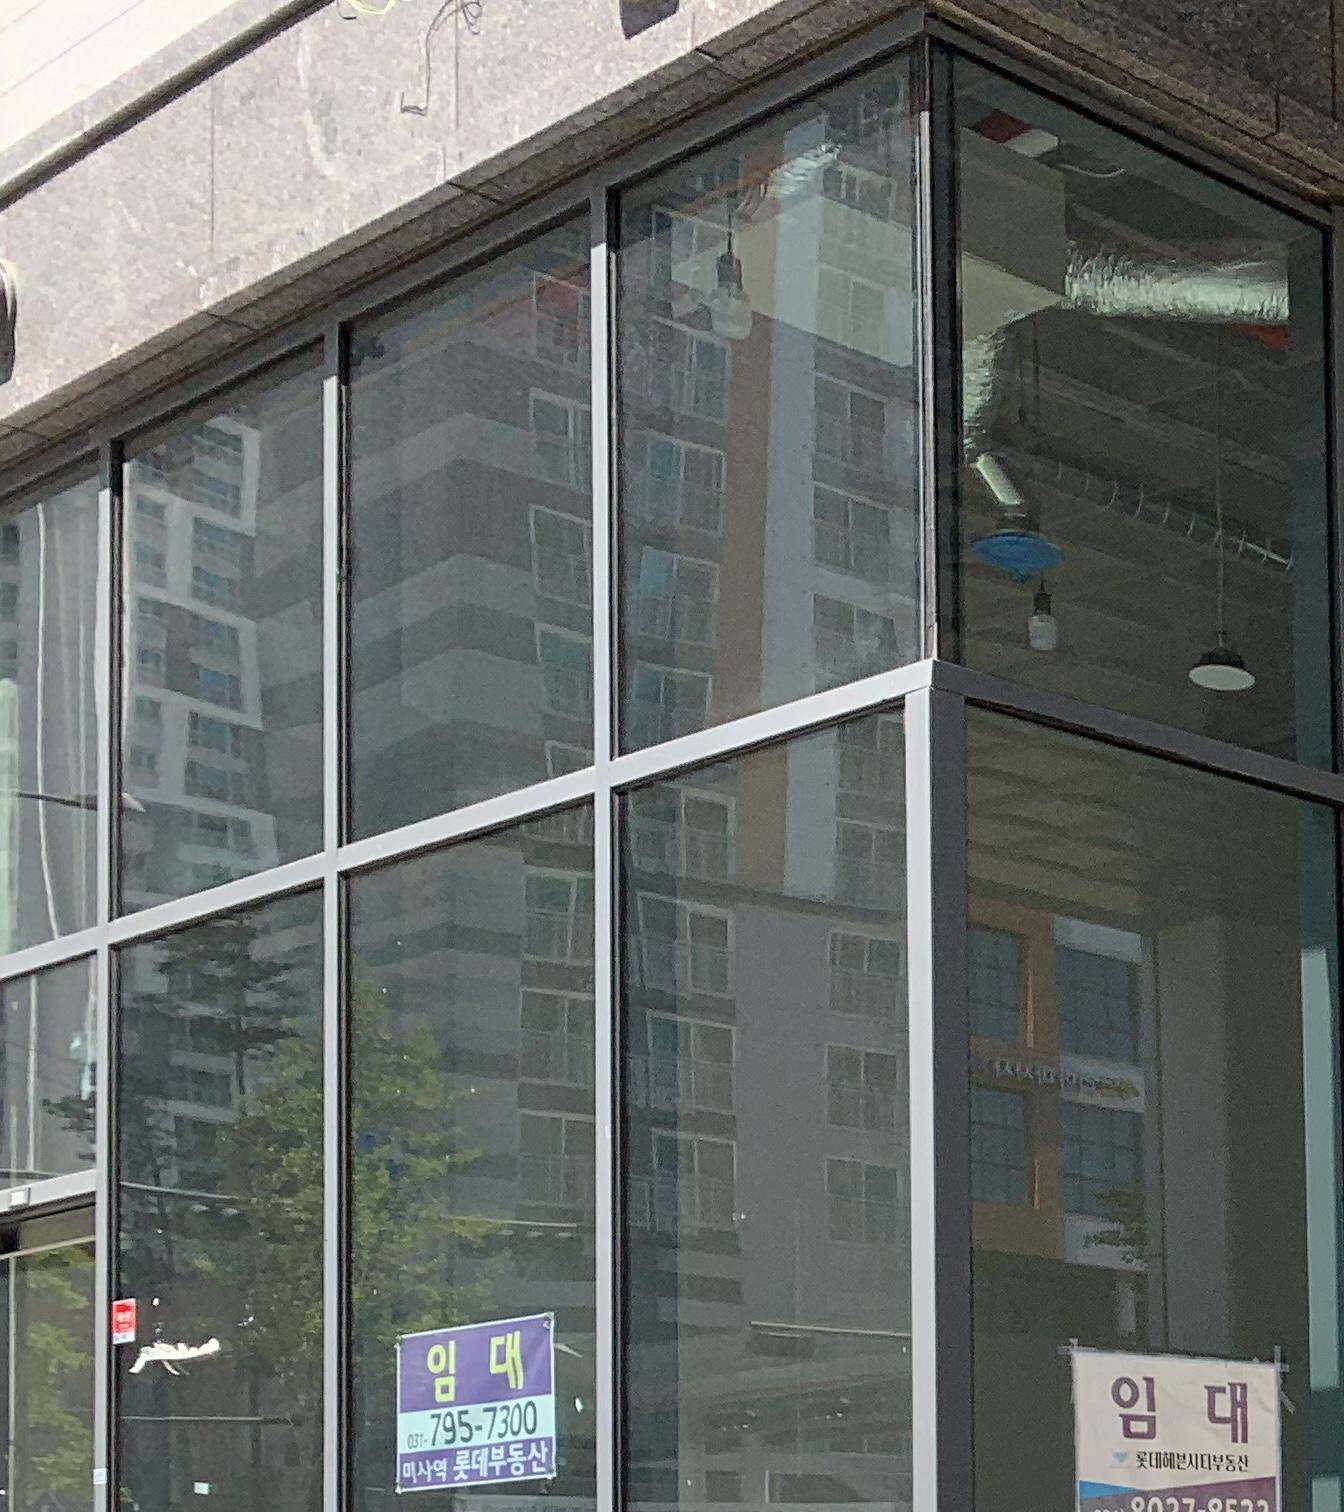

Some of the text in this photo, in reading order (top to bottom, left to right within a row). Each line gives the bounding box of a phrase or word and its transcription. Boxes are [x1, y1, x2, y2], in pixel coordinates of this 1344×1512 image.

[402, 1439, 548, 1484] 미사역 롯데부동산
[1135, 1450, 1249, 1473] 롯데헤븐시티부동산
